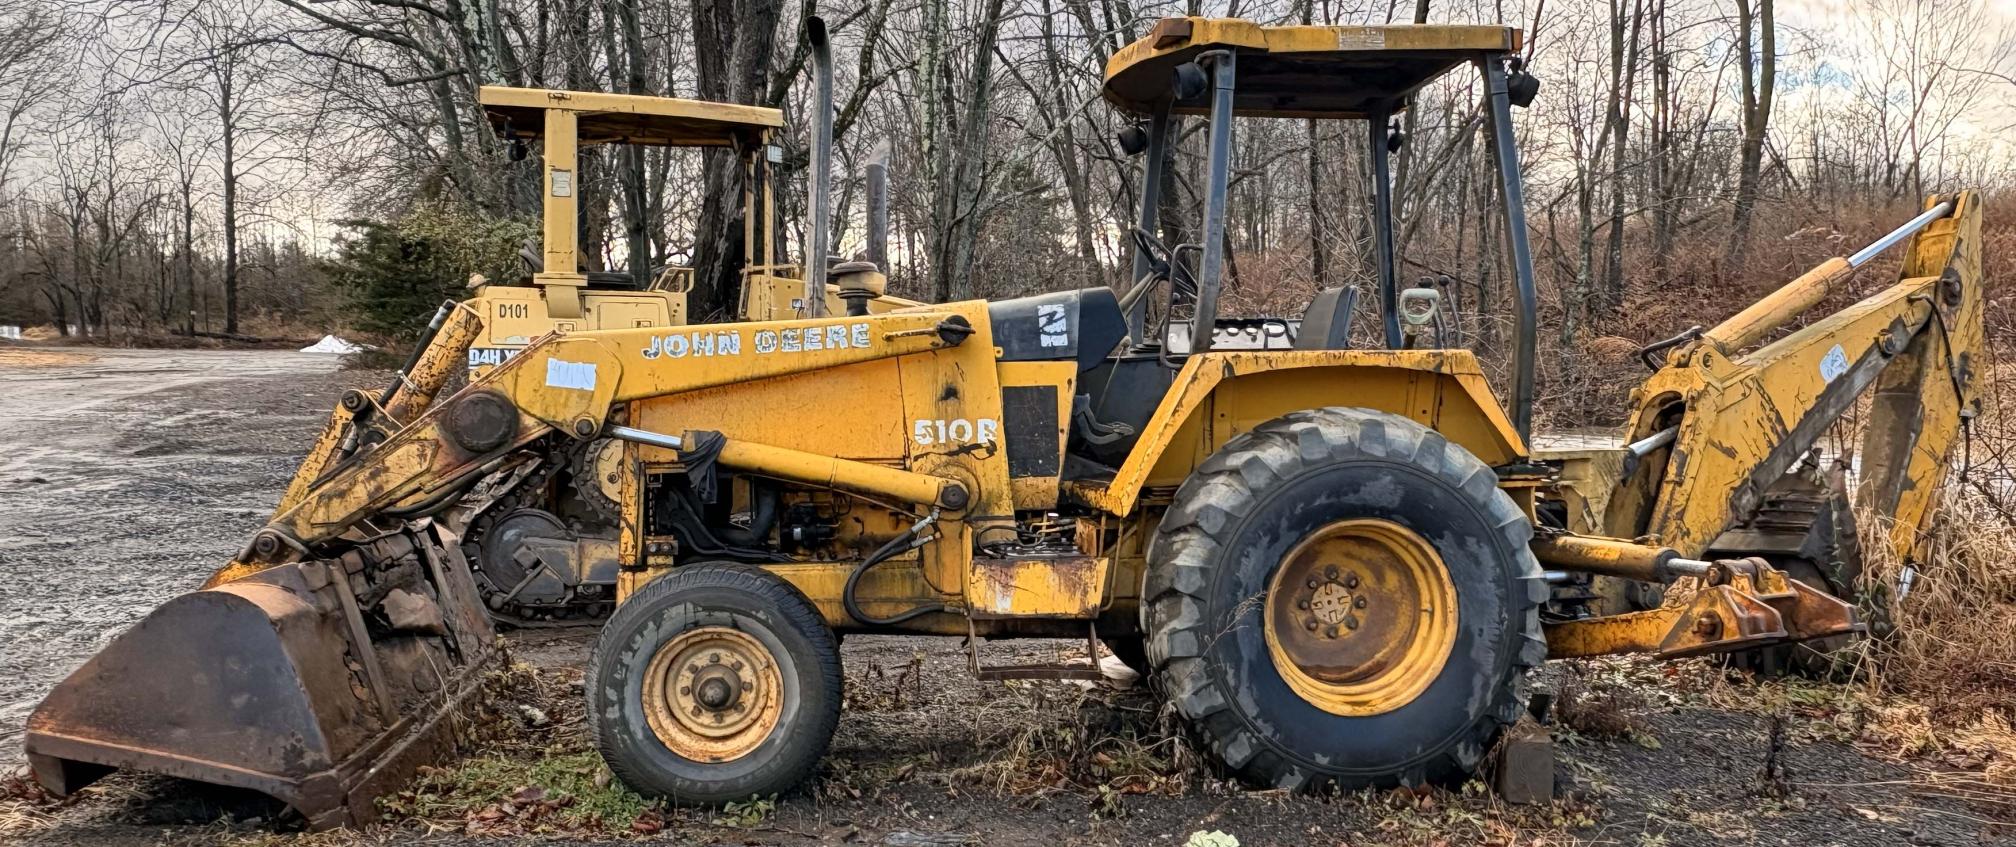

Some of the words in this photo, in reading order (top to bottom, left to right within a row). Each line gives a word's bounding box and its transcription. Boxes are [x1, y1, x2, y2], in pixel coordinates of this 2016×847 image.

[499, 303, 528, 319] D101
[641, 331, 741, 359] JOHN
[754, 323, 871, 353] DEERE
[469, 349, 500, 365] D4H
